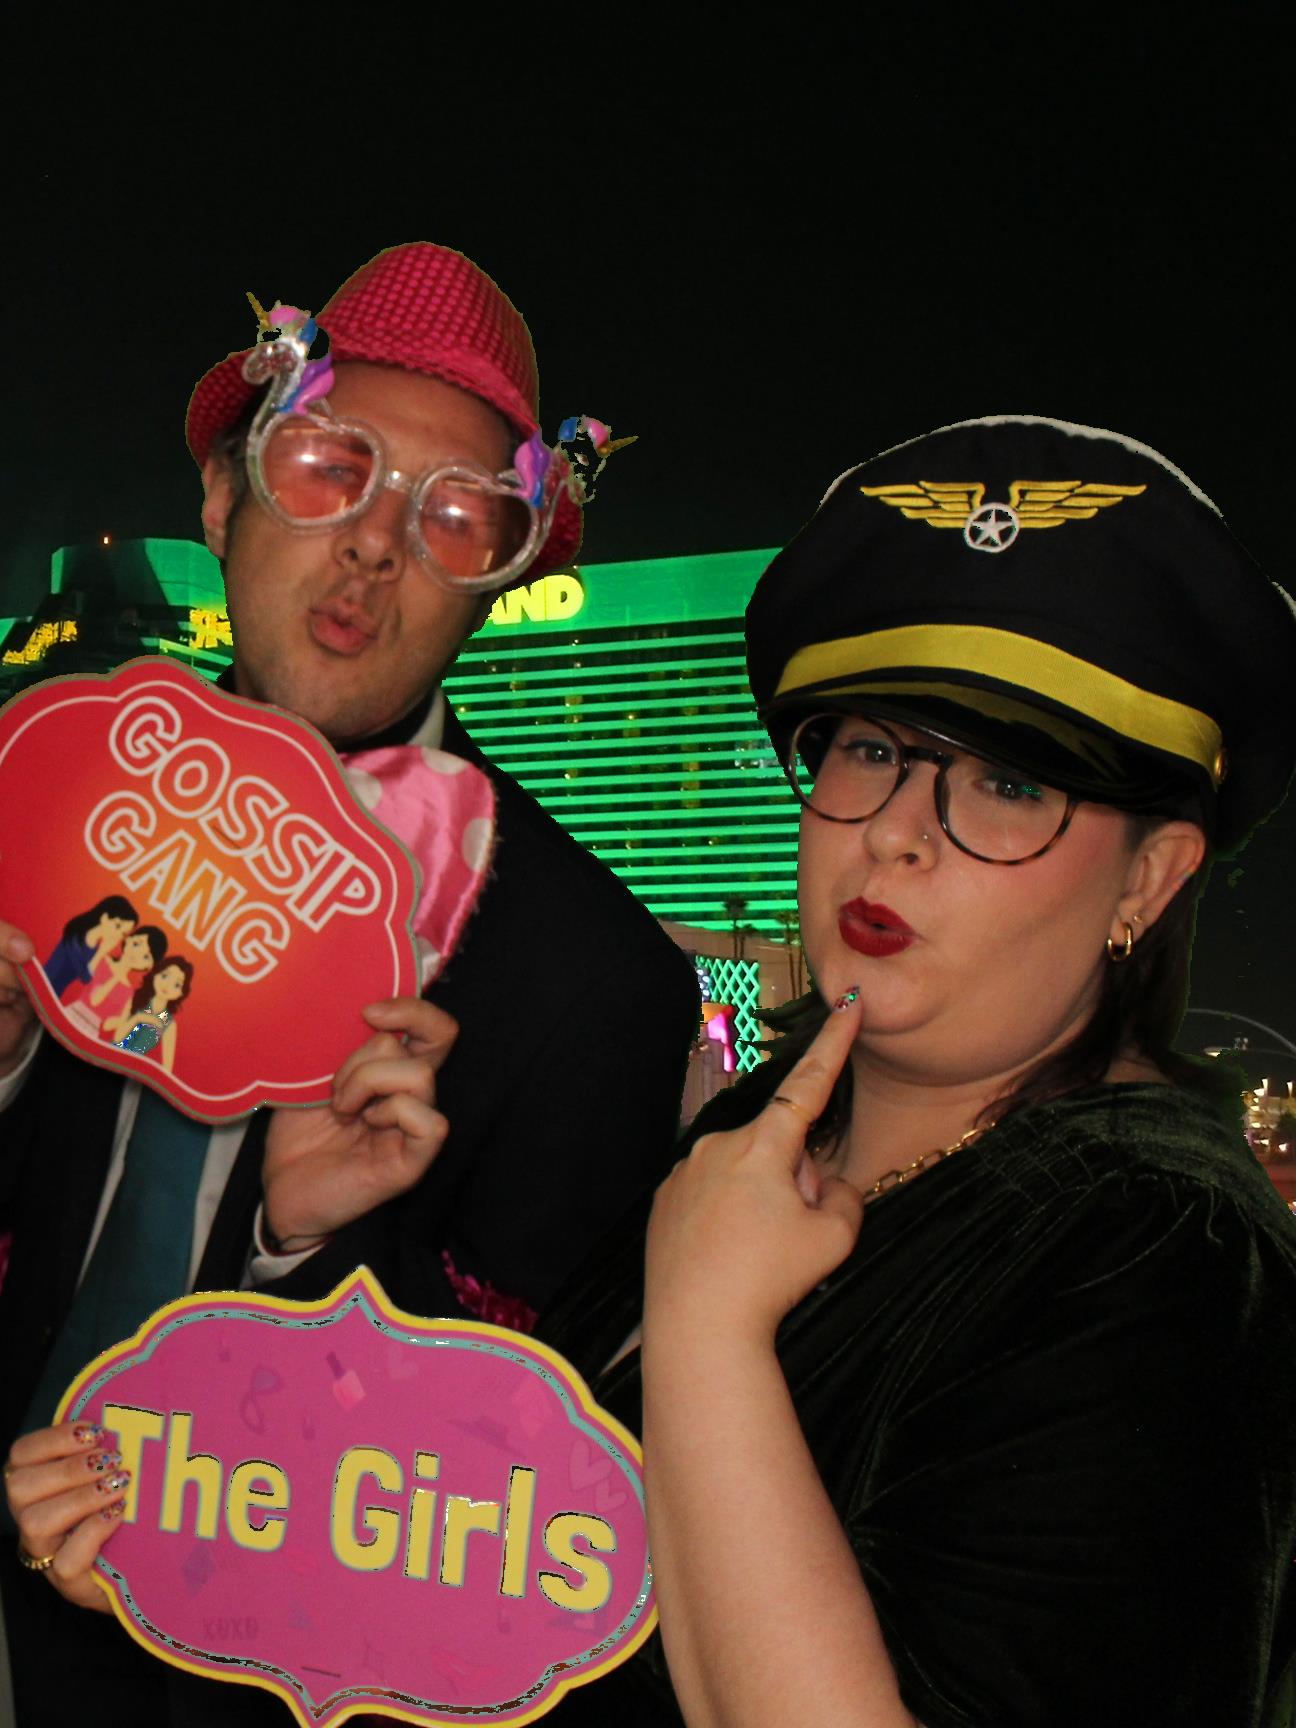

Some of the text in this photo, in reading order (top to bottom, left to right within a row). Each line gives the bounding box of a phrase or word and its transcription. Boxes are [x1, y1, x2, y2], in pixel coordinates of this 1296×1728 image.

[84, 790, 290, 983] GANG
[109, 696, 381, 931] GOSSIP
[104, 1403, 616, 1613] The Girls
